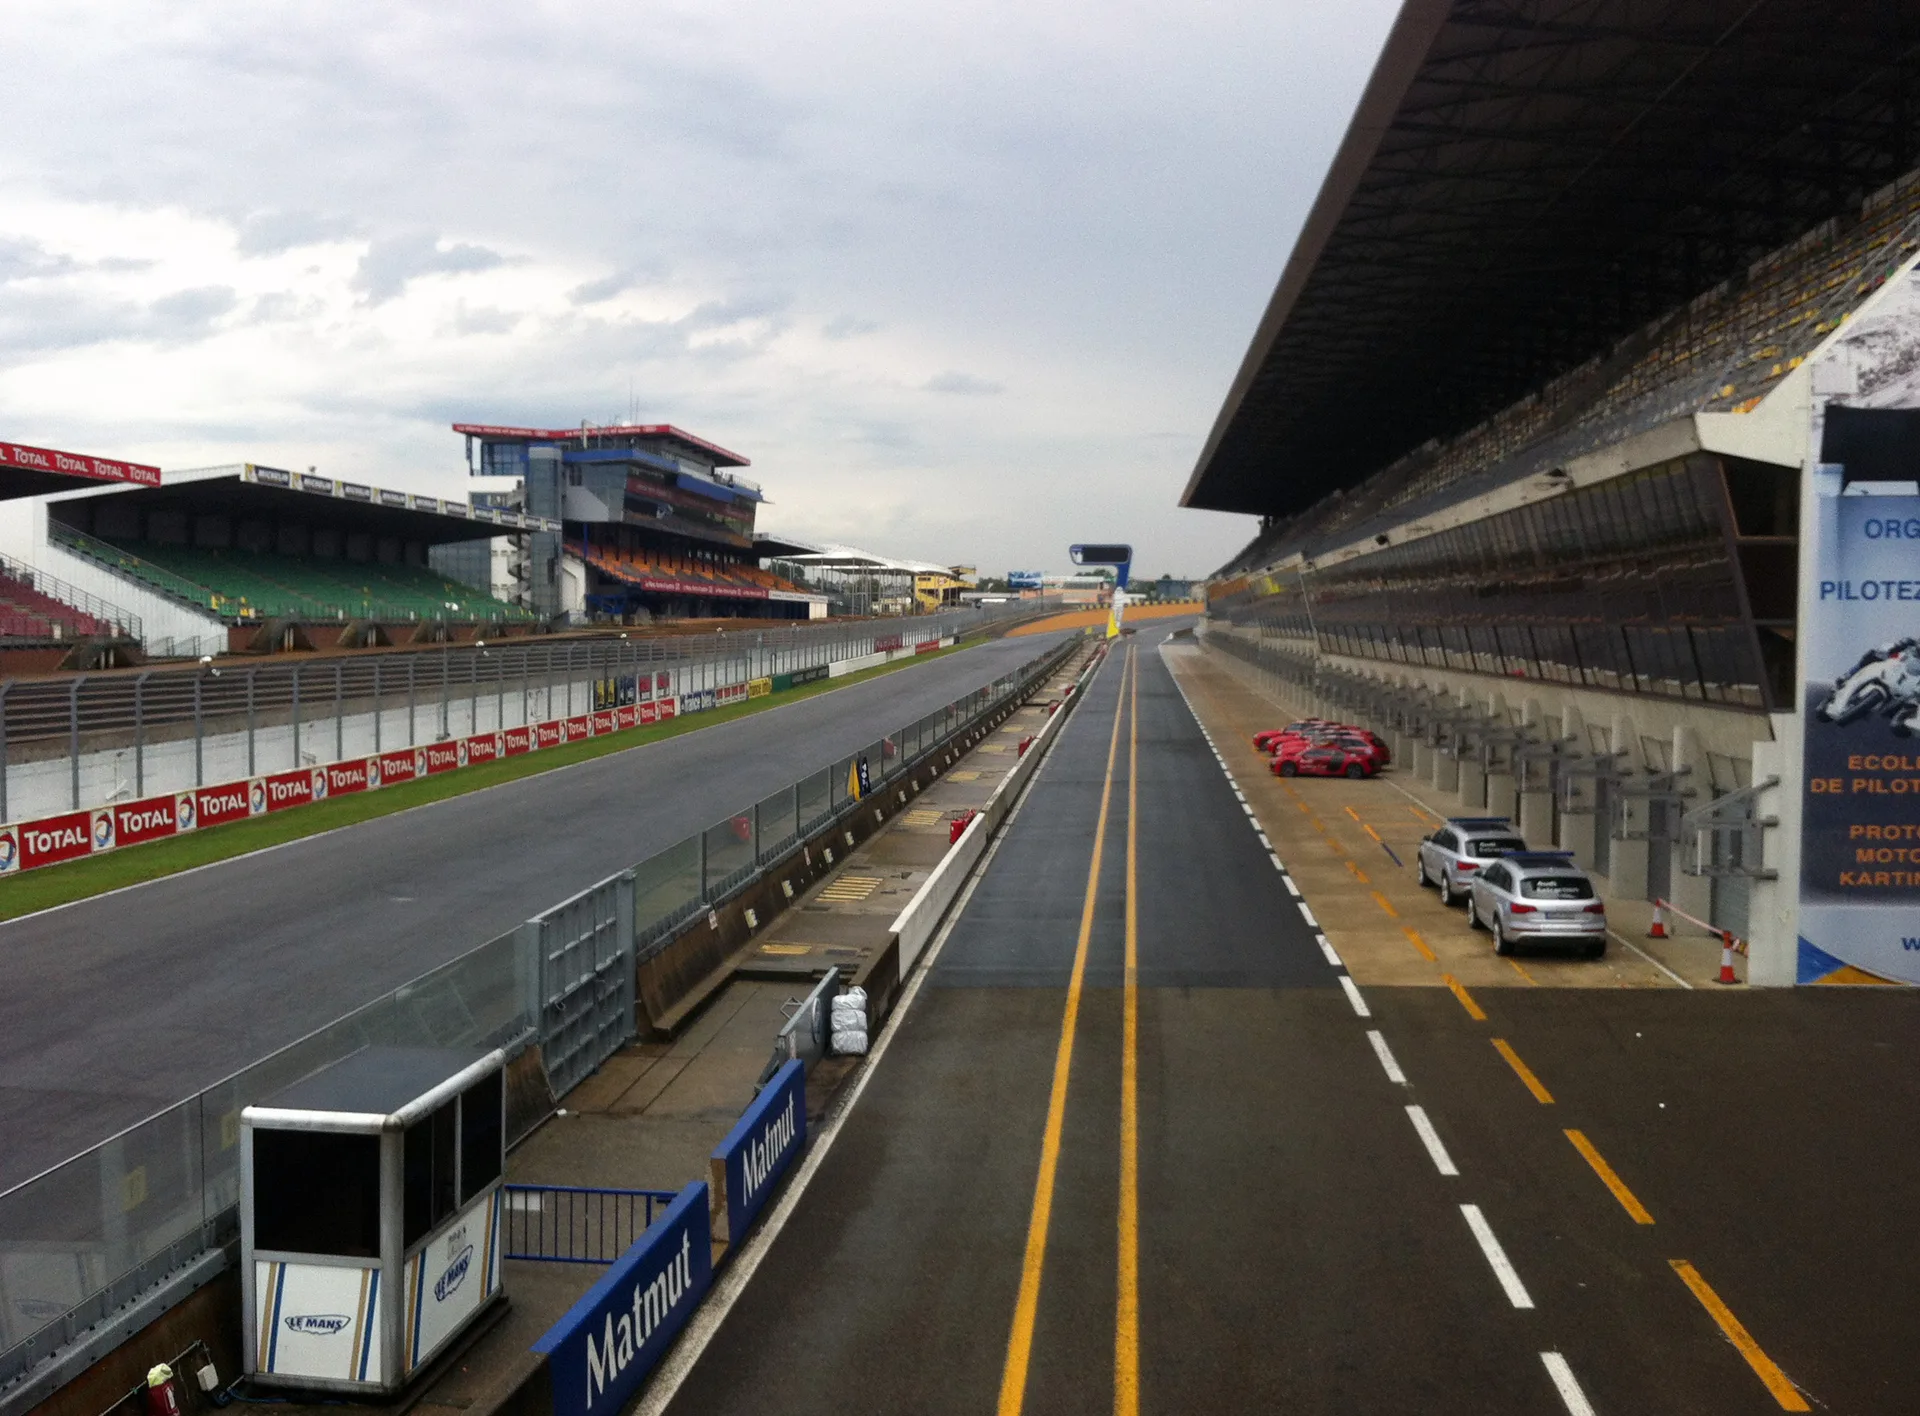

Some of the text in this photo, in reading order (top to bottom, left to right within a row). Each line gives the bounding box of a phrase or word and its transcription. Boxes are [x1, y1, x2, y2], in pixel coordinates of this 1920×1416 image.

[12, 447, 49, 467] TOTAL
[55, 453, 89, 473] TOTAL
[93, 459, 124, 478] TOTAL
[128, 465, 159, 483] TOTAL
[1864, 518, 1920, 539] ORG
[24, 826, 88, 855] TOTAL
[119, 808, 174, 834] TOTAL
[200, 792, 247, 817] TOTAL
[269, 780, 310, 801] TOTAL
[330, 769, 366, 788] TOTAL
[382, 759, 414, 776] TOTAL
[429, 749, 456, 766] TOTAL
[469, 742, 495, 756] TOTAL
[506, 734, 529, 748] TOTAL
[538, 727, 559, 740] TOTAL
[567, 721, 587, 734] TOTAL
[1811, 779, 1843, 793] DE
[1850, 825, 1920, 840] PROT
[742, 1090, 796, 1207] Matmut
[436, 1255, 469, 1297] LE MANS
[290, 1317, 343, 1330] LE MANS
[587, 1228, 692, 1411] Matmut
